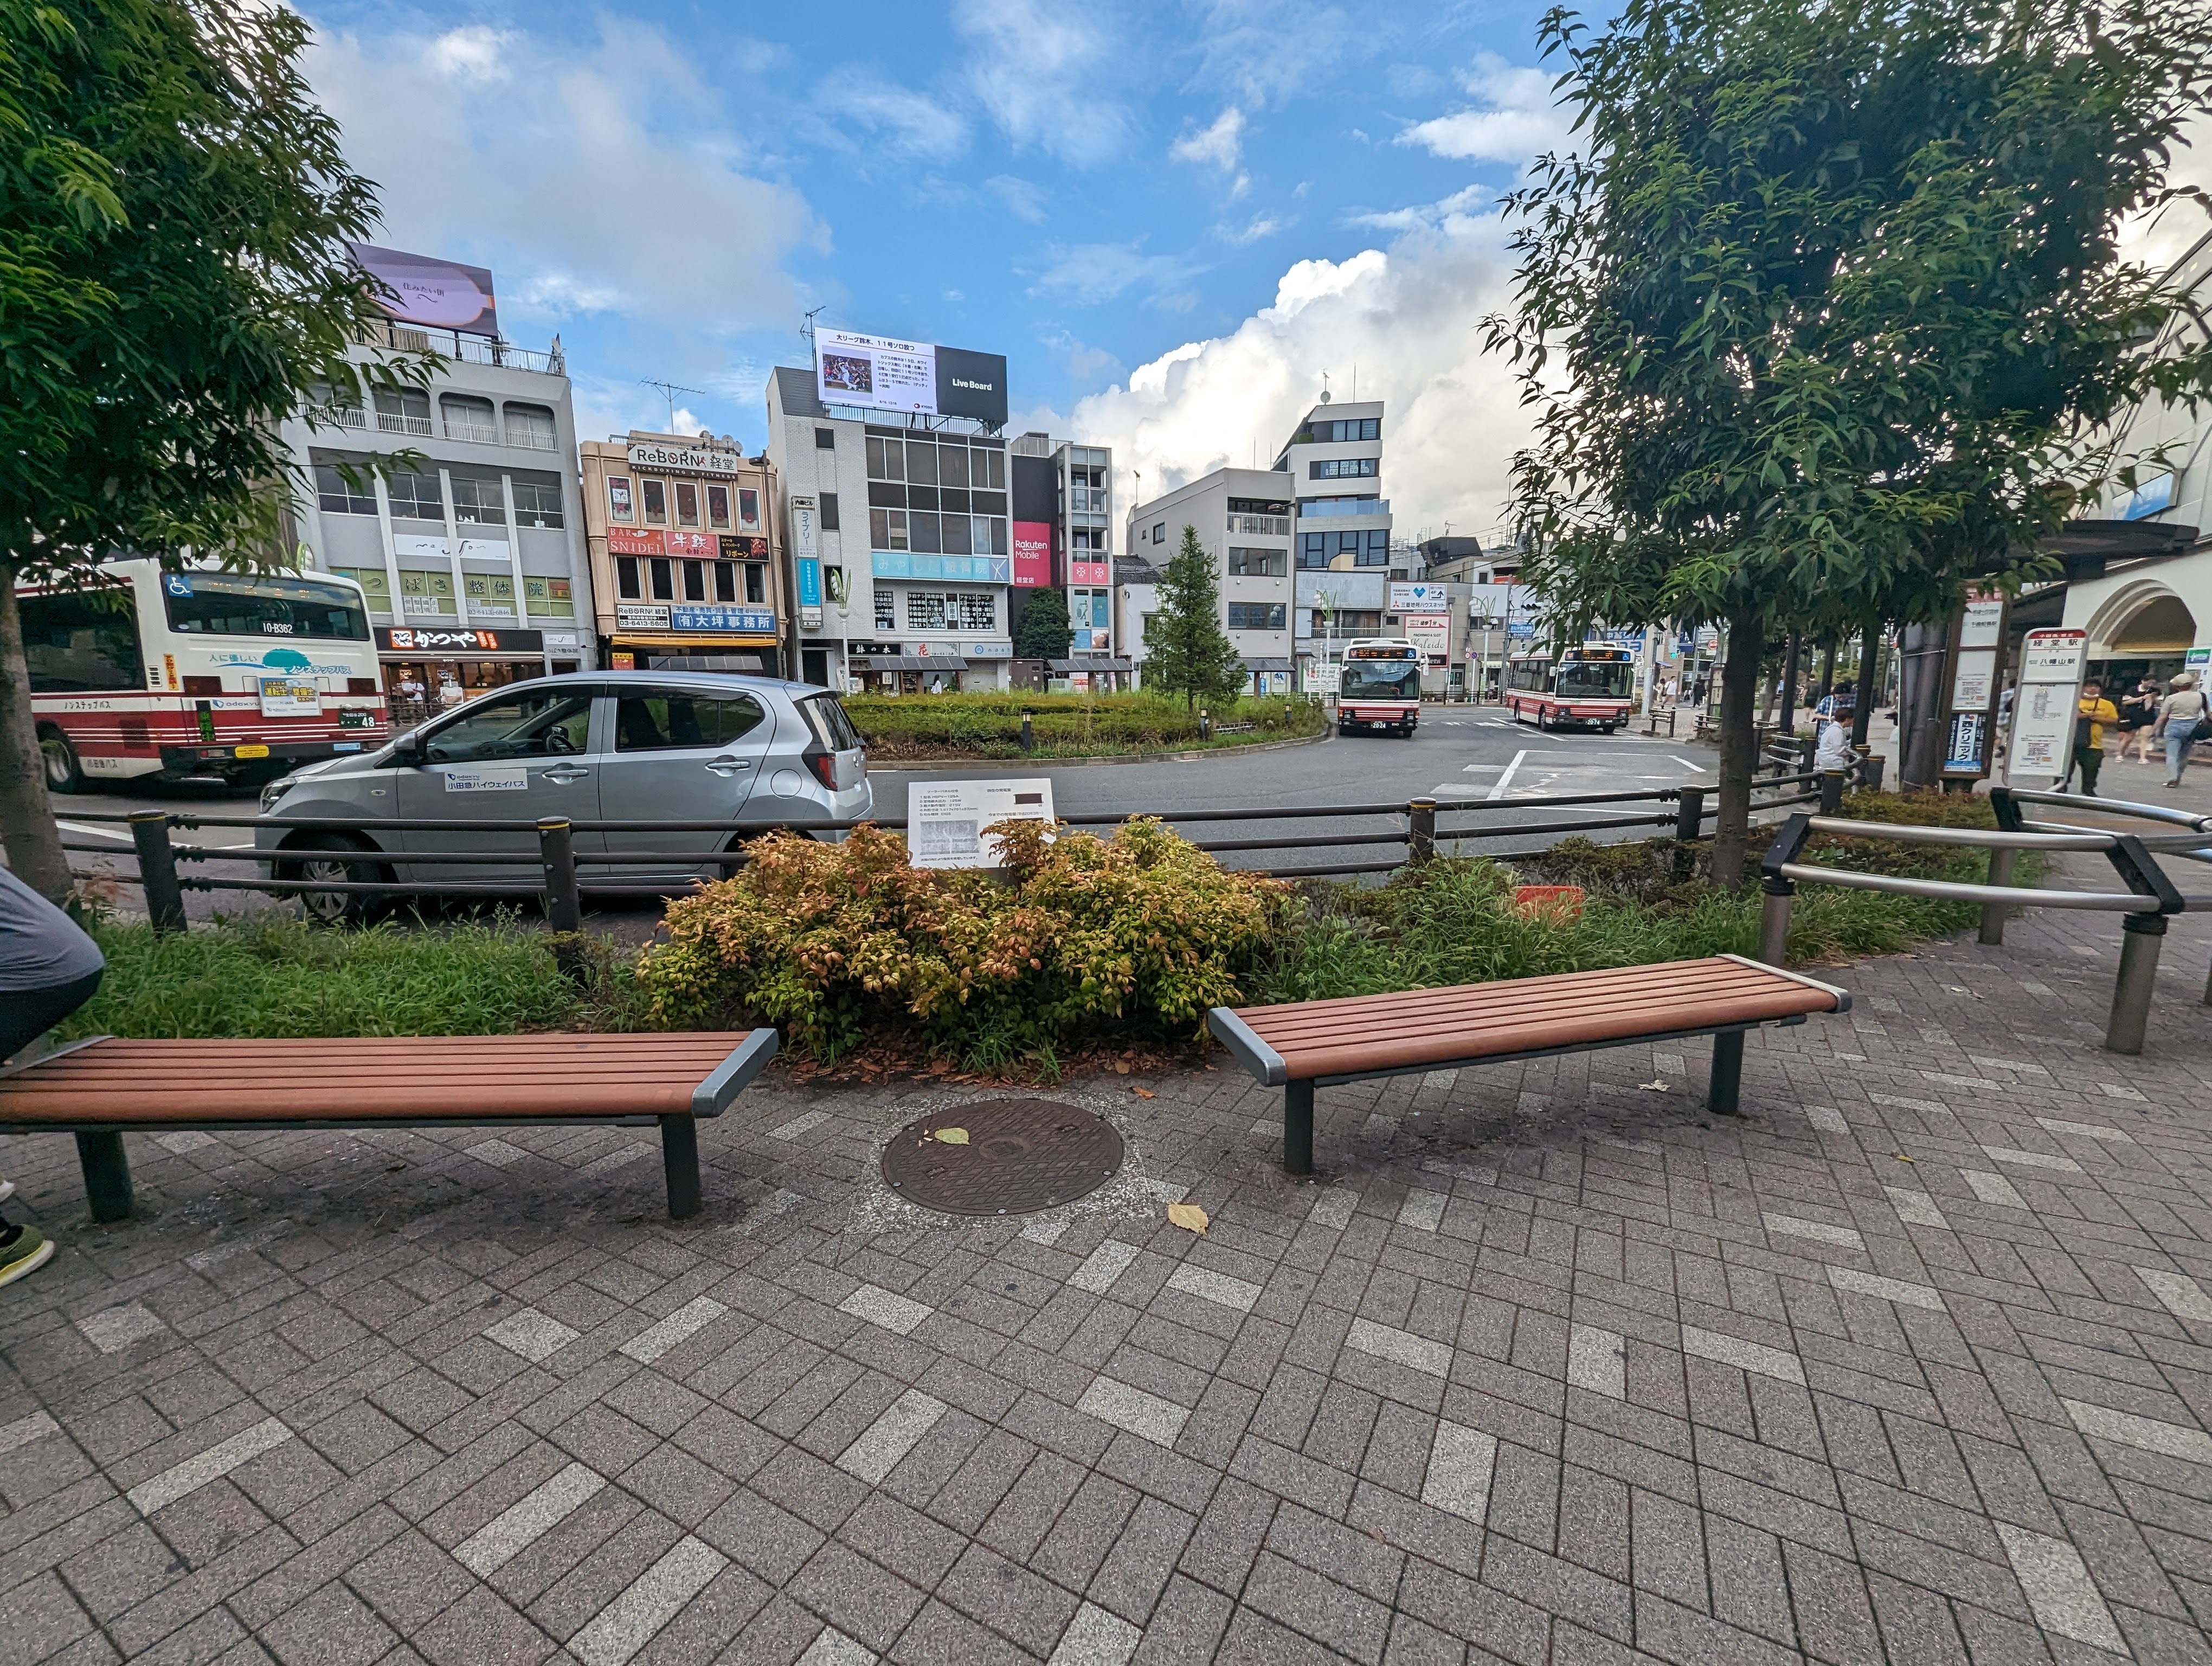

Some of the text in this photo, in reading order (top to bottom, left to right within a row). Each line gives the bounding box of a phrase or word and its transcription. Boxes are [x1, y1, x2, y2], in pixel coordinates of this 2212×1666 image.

[952, 378, 992, 391] Live Board
[637, 448, 735, 470] ReBORN 経堂
[632, 465, 685, 475] KICKBOXING
[610, 528, 632, 537] BAR
[801, 511, 809, 546] ライブリー
[610, 541, 664, 555] SNIDEL
[1015, 540, 1047, 549] Rakuten
[726, 550, 749, 558] リボーン
[1015, 551, 1039, 559] Mobile
[366, 577, 544, 596] つばさ整体院
[678, 615, 770, 628] (有)大坪事務所
[414, 630, 477, 648] かつや
[856, 644, 891, 654] 鉢の木
[918, 643, 929, 656] 花
[209, 653, 257, 662] 人に優しい
[289, 665, 352, 674] ノンステップバス
[448, 781, 525, 789] 小田急ハイウェイバス
